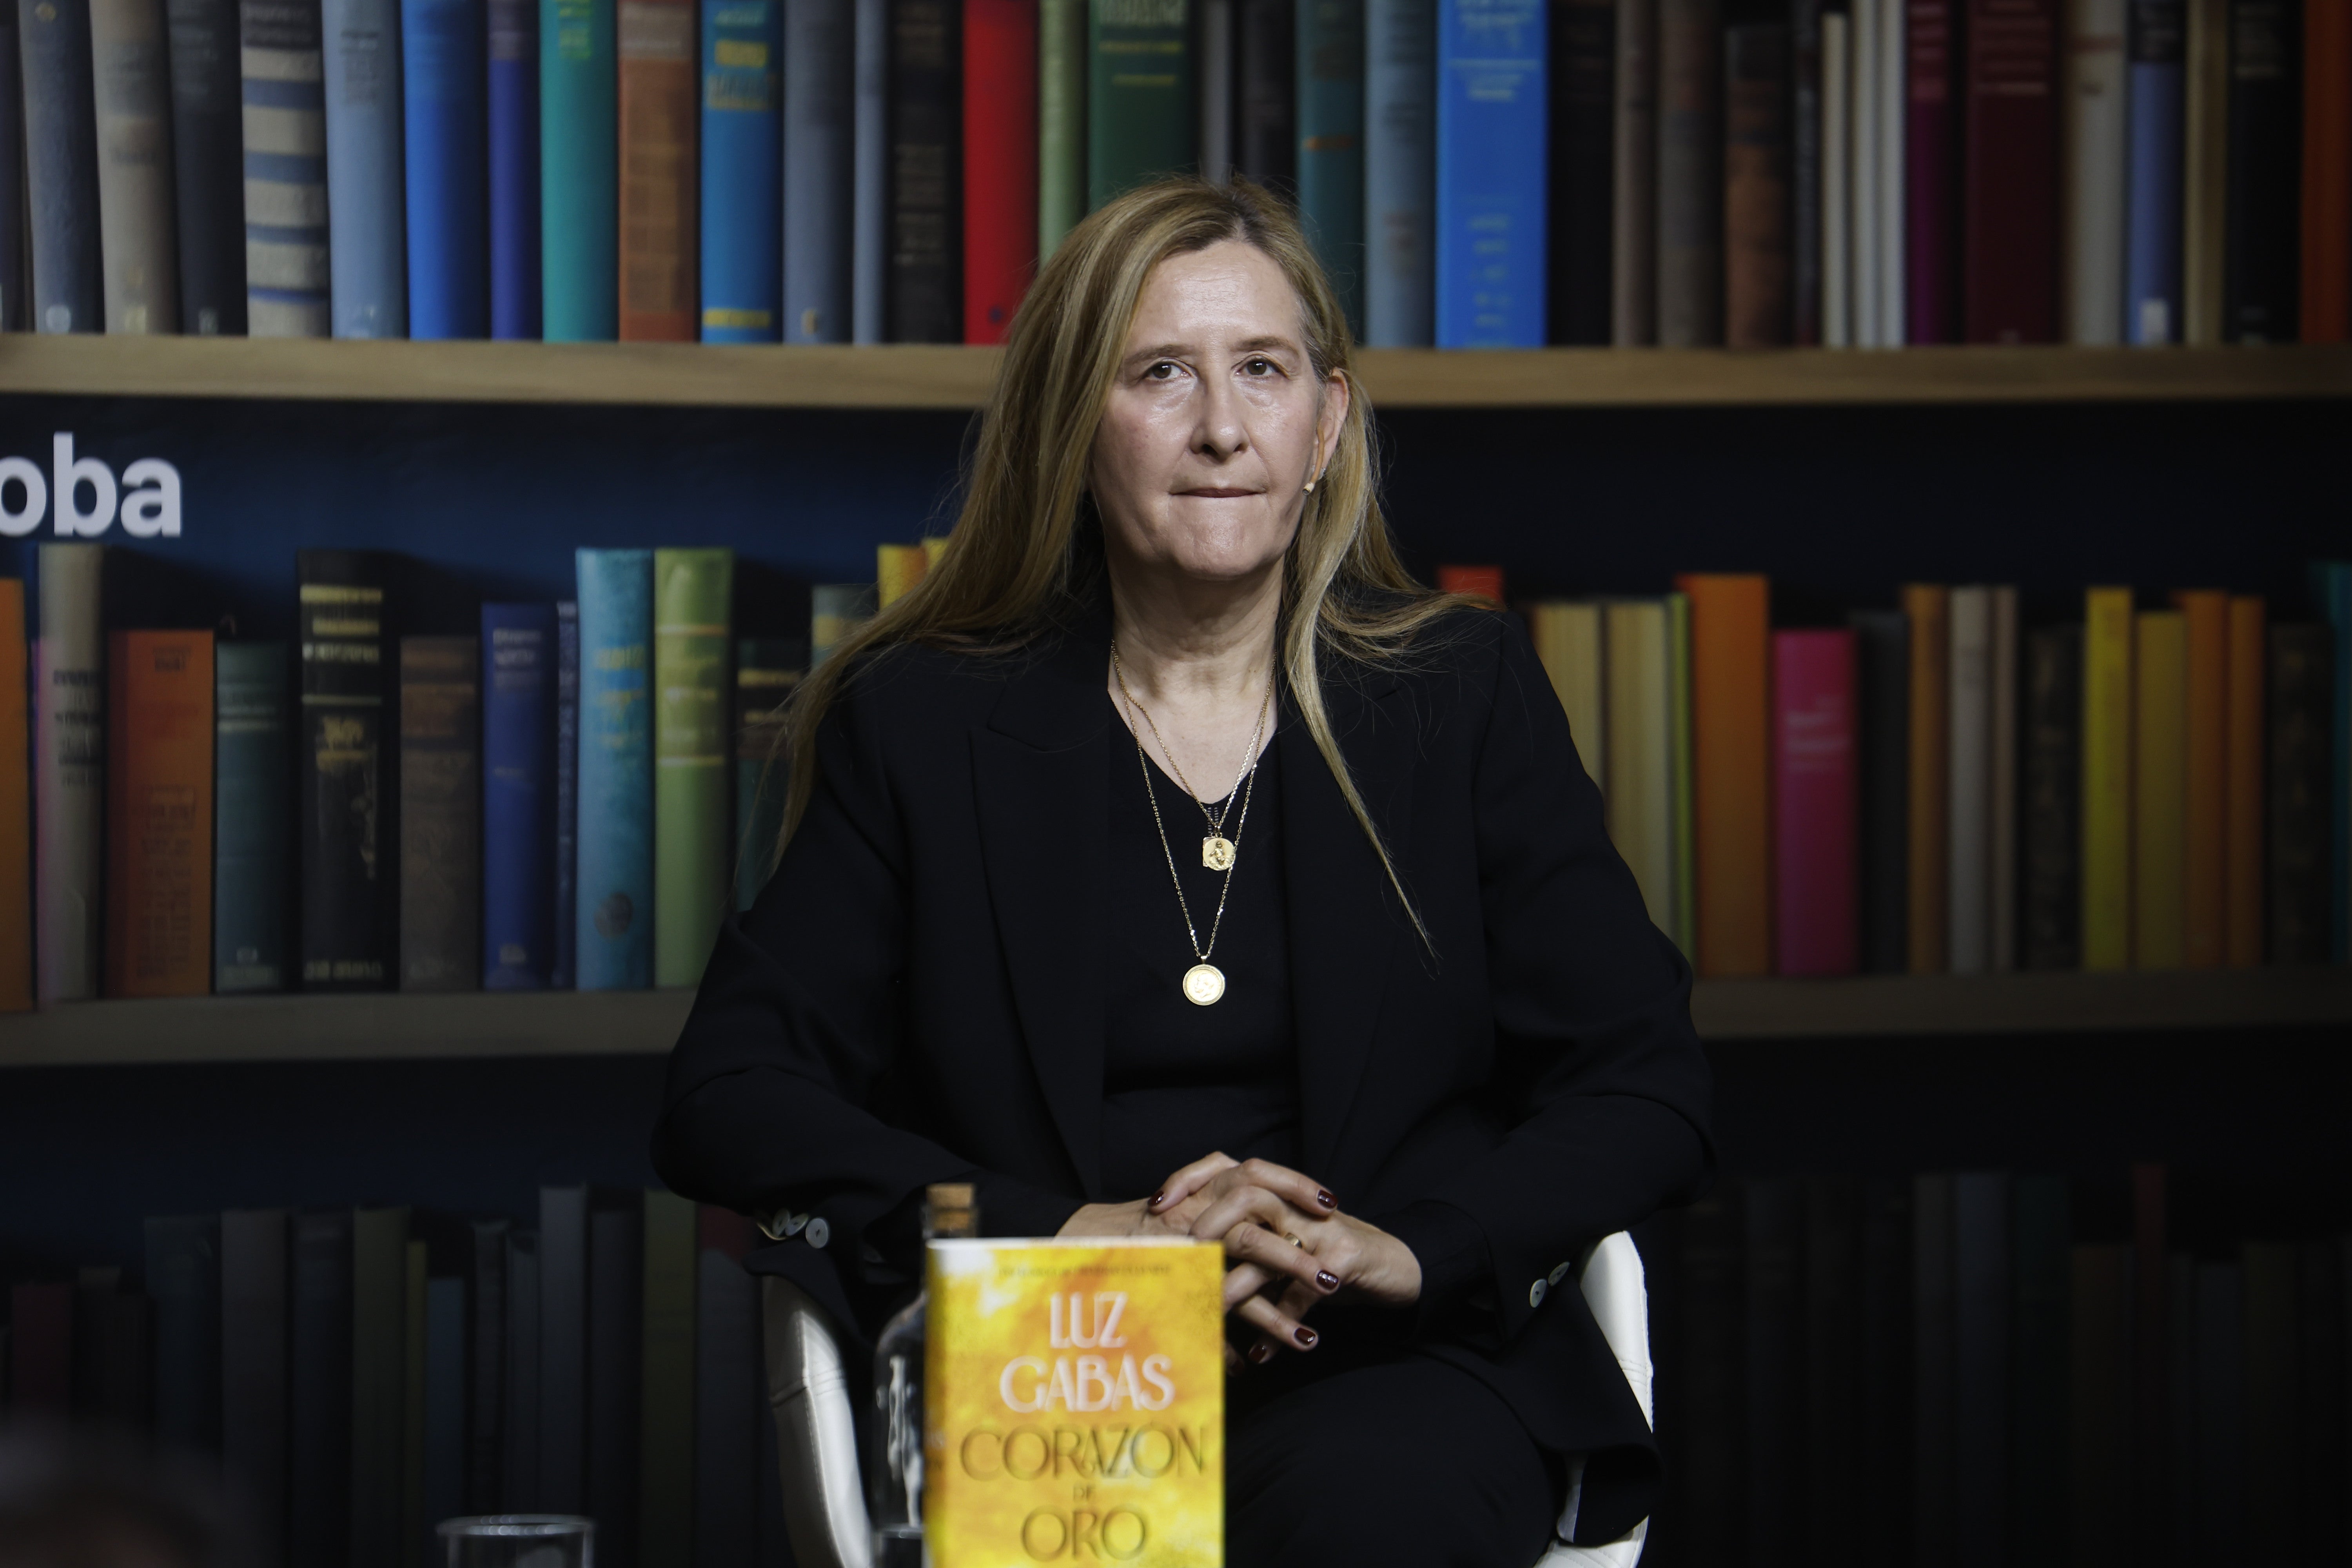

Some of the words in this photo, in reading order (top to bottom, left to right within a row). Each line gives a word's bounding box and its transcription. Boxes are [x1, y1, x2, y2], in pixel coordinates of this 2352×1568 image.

[0, 431, 181, 537] oba
[1049, 1291, 1129, 1348] LUZ
[1022, 1504, 1149, 1562] ORO
